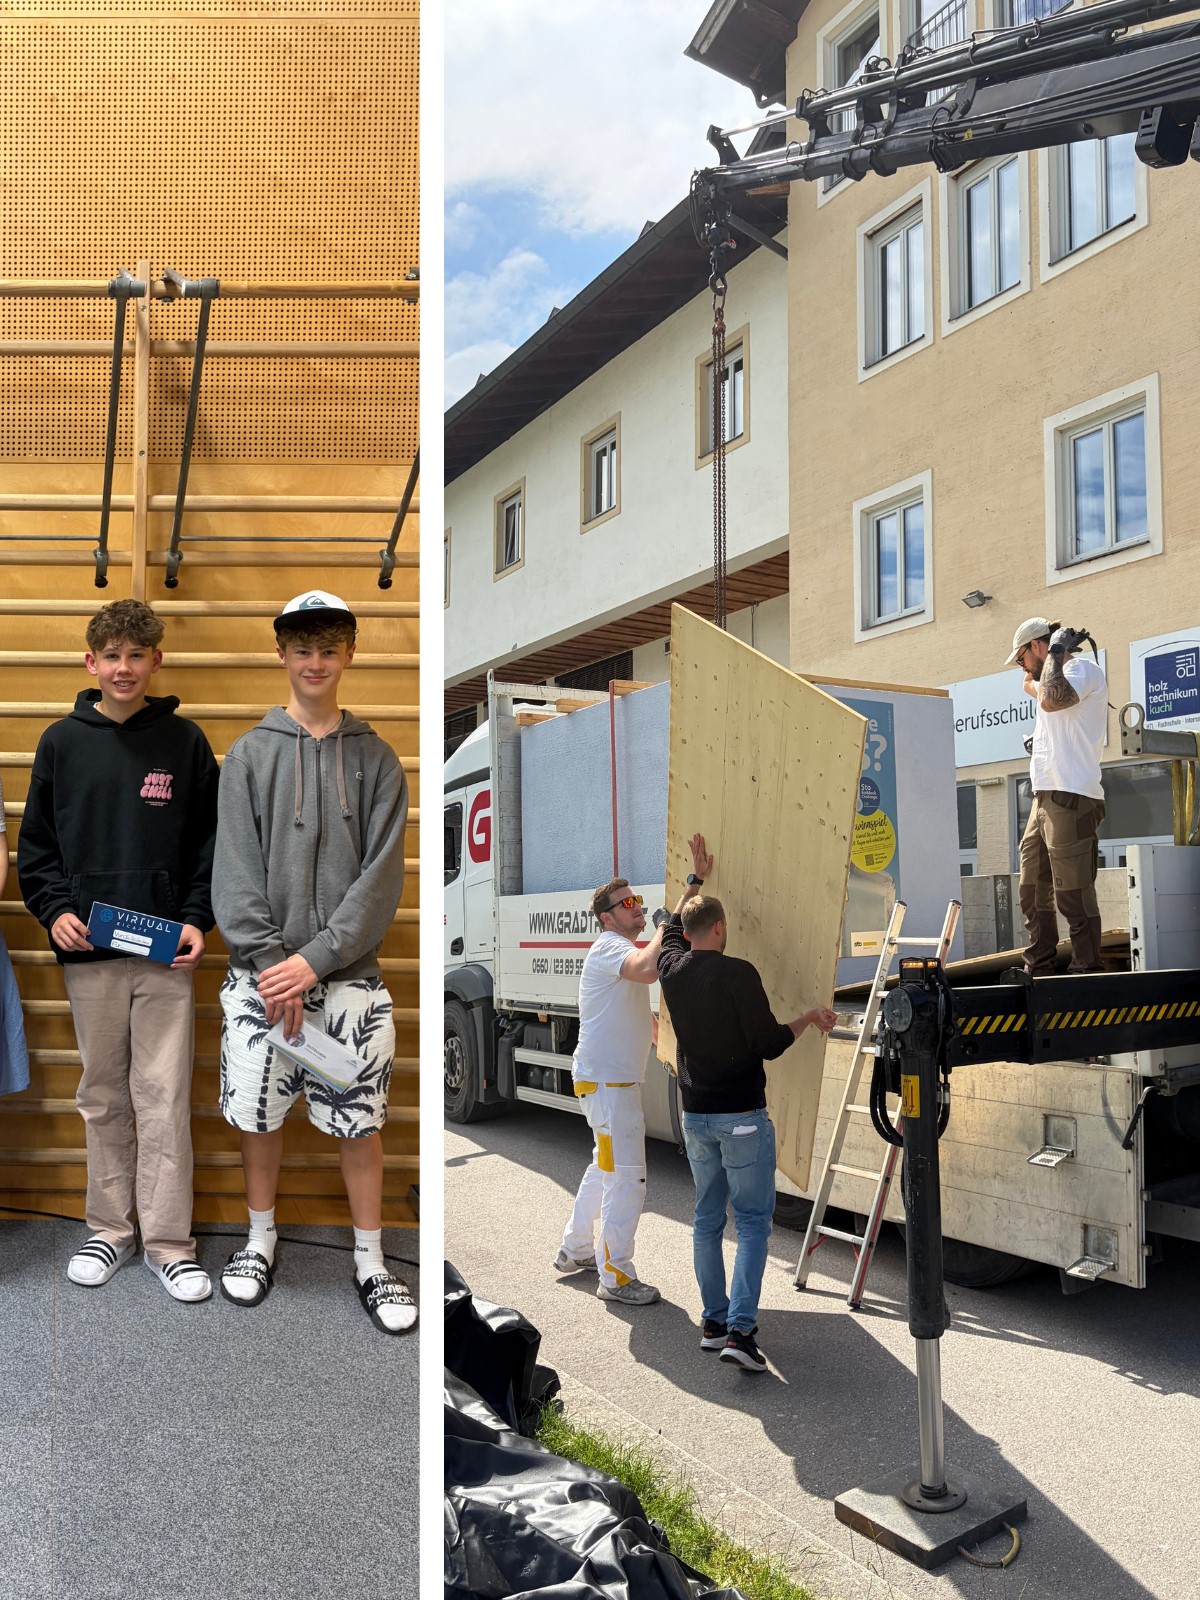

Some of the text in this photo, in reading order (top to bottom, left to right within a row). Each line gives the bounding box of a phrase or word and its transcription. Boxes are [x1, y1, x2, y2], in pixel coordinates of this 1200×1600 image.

[1148, 680, 1168, 693] holz
[1148, 688, 1197, 703] technikum
[1149, 701, 1172, 715] kuchl
[953, 699, 1037, 733] erufsschül
[144, 773, 173, 787] JUST
[861, 783, 871, 791] Sto
[467, 789, 492, 863] G
[117, 911, 171, 933] VIRTUAL
[553, 958, 563, 974] 123
[564, 958, 574, 975] 89
